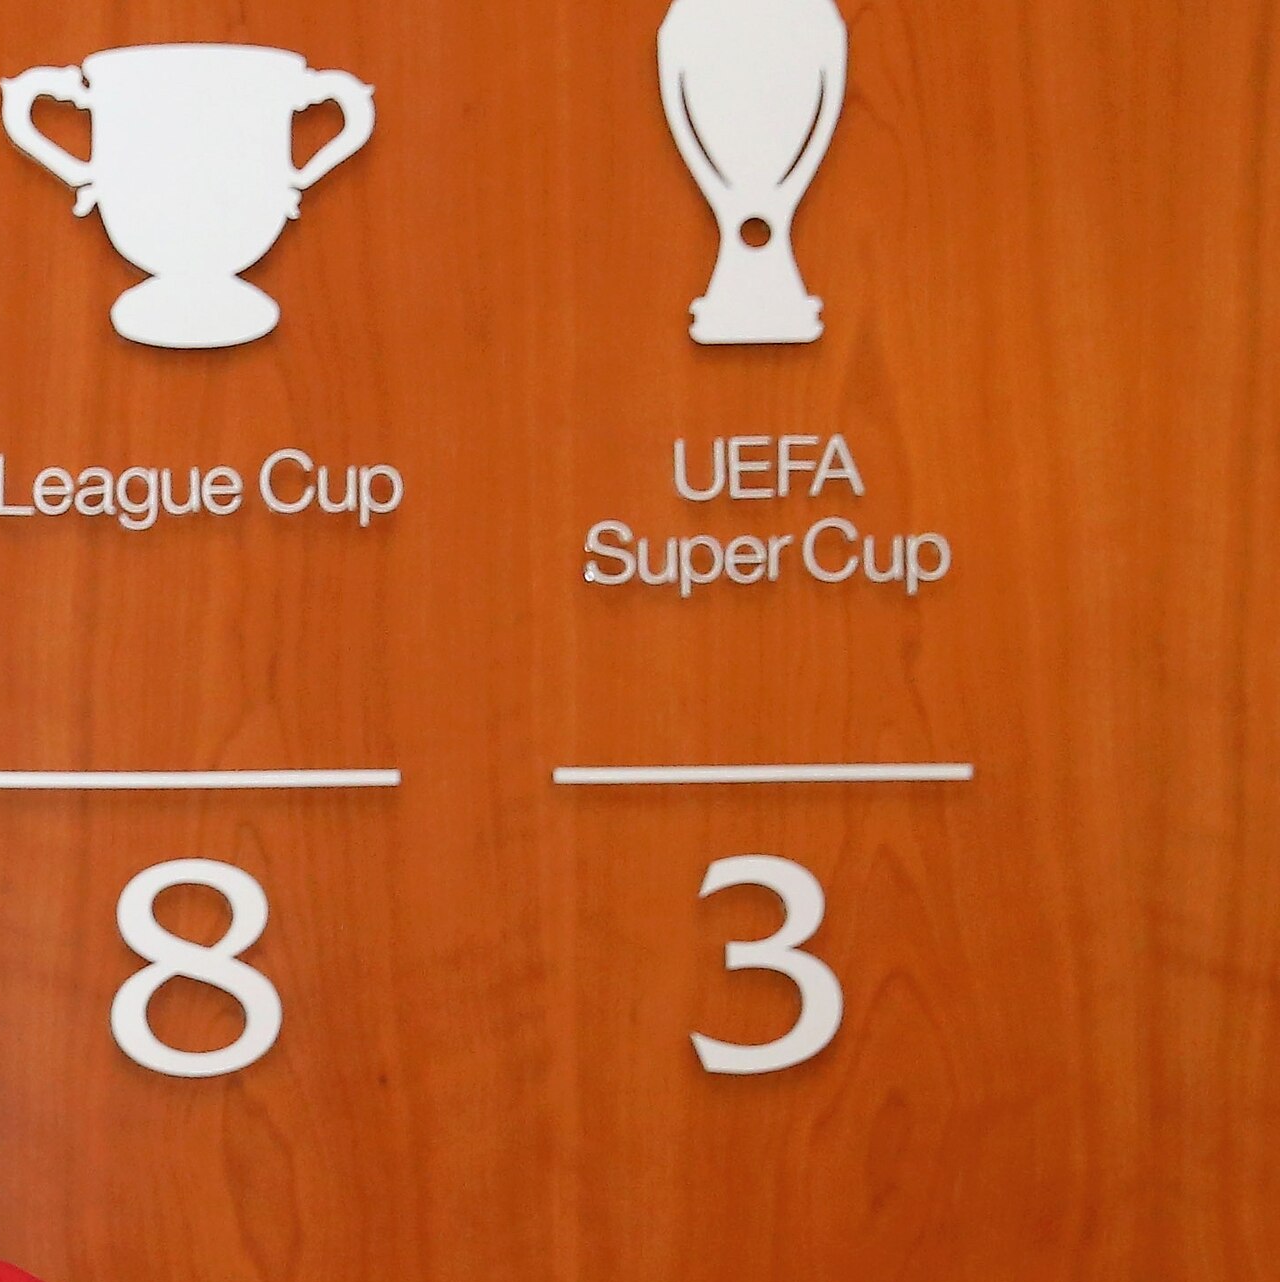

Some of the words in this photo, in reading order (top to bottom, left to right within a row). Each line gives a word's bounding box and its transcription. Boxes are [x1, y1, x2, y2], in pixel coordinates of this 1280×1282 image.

[259, 449, 404, 528] Cup
[674, 434, 865, 501] UEFA
[583, 519, 794, 598] Super
[802, 517, 952, 595] Cup
[110, 858, 283, 1078] 8
[690, 854, 844, 1075] 3
